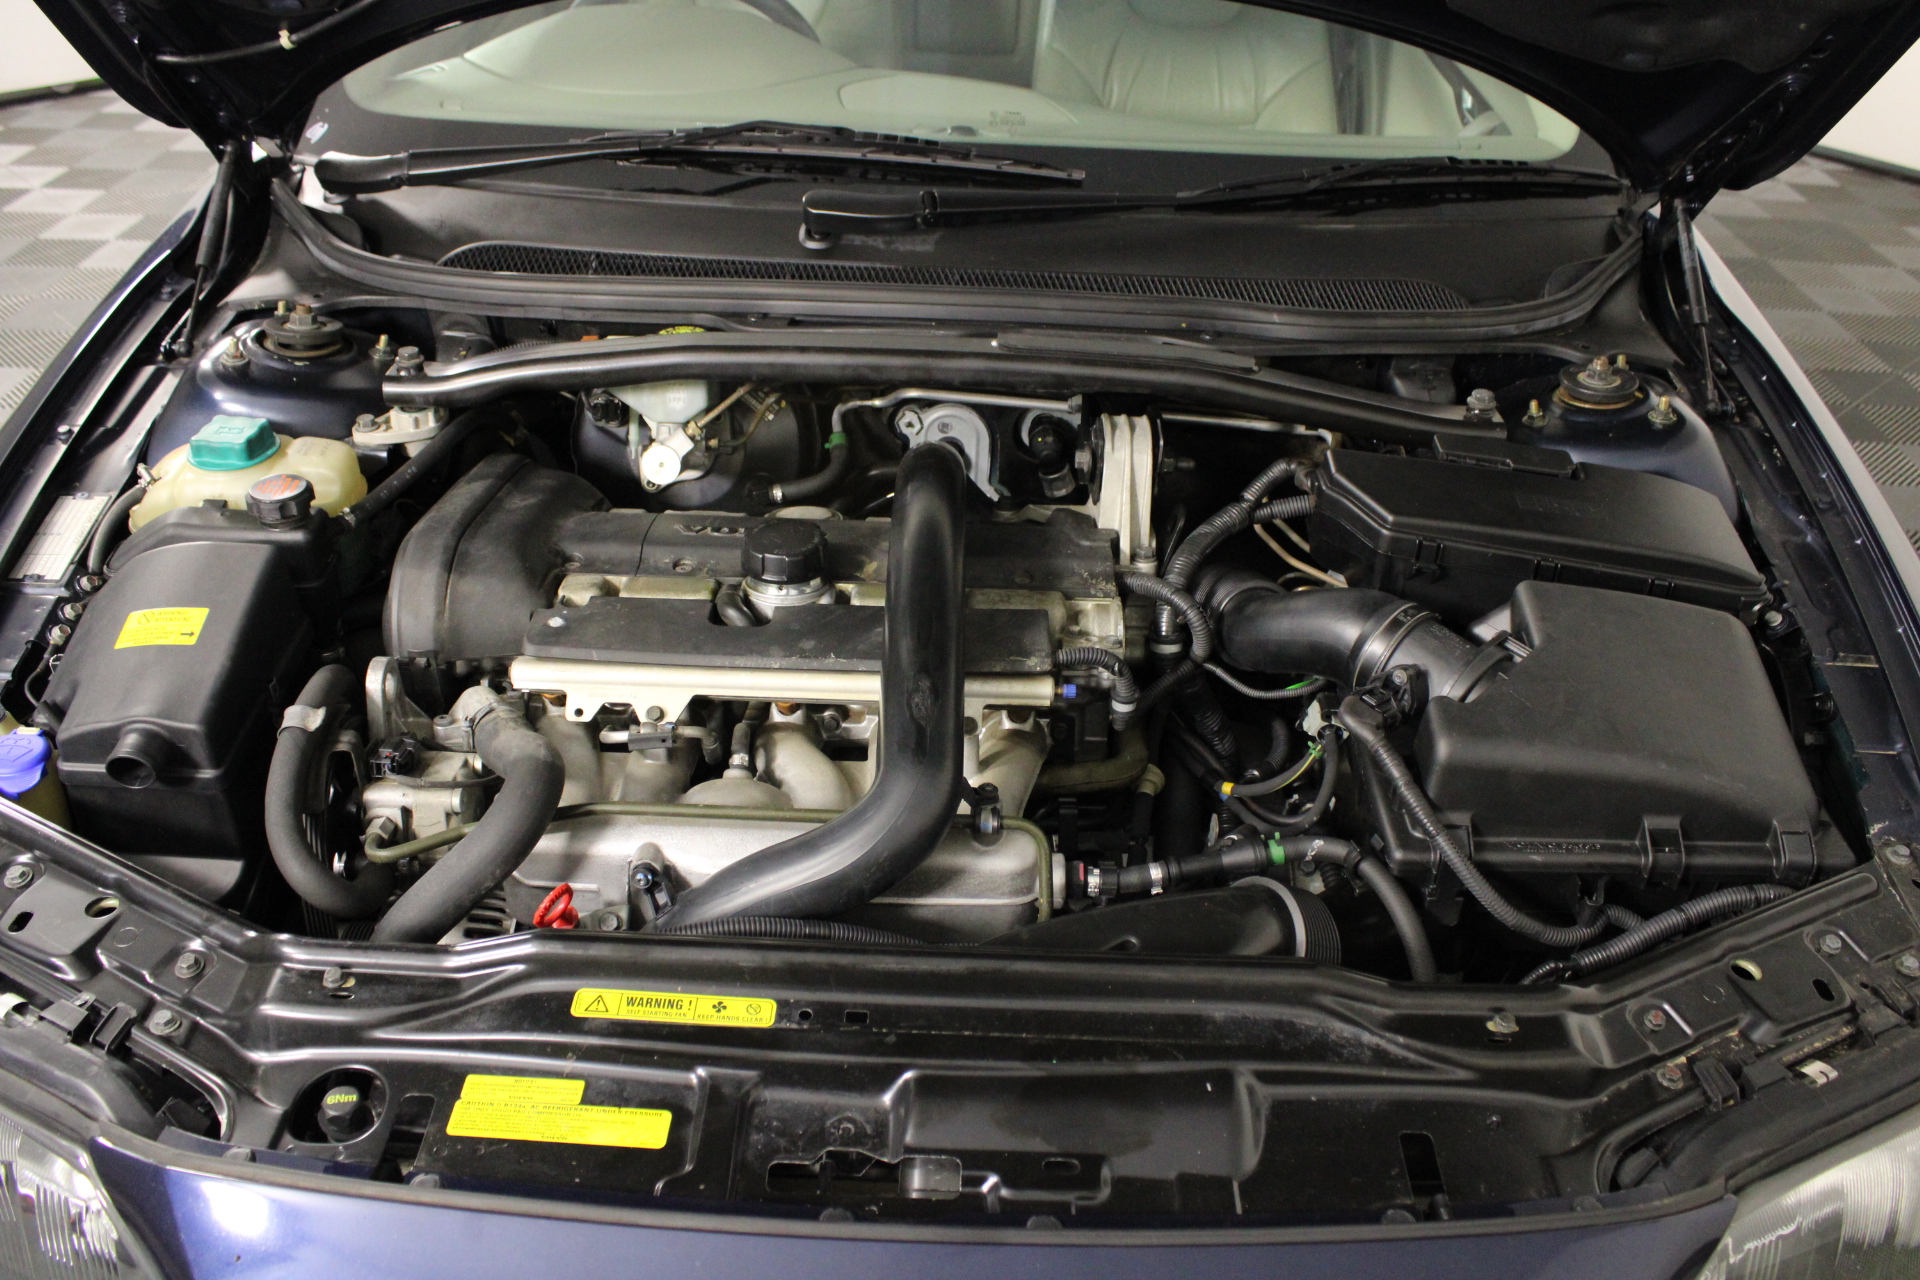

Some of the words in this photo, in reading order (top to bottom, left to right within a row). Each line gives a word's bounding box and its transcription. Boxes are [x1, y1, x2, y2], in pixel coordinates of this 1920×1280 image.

[626, 996, 684, 1010] WARNING
[642, 1010, 673, 1018] STARTING
[326, 1093, 357, 1105] 6Nm
[542, 1105, 594, 1113] REFRIGERANT
[624, 1110, 664, 1118] PRESSURE
